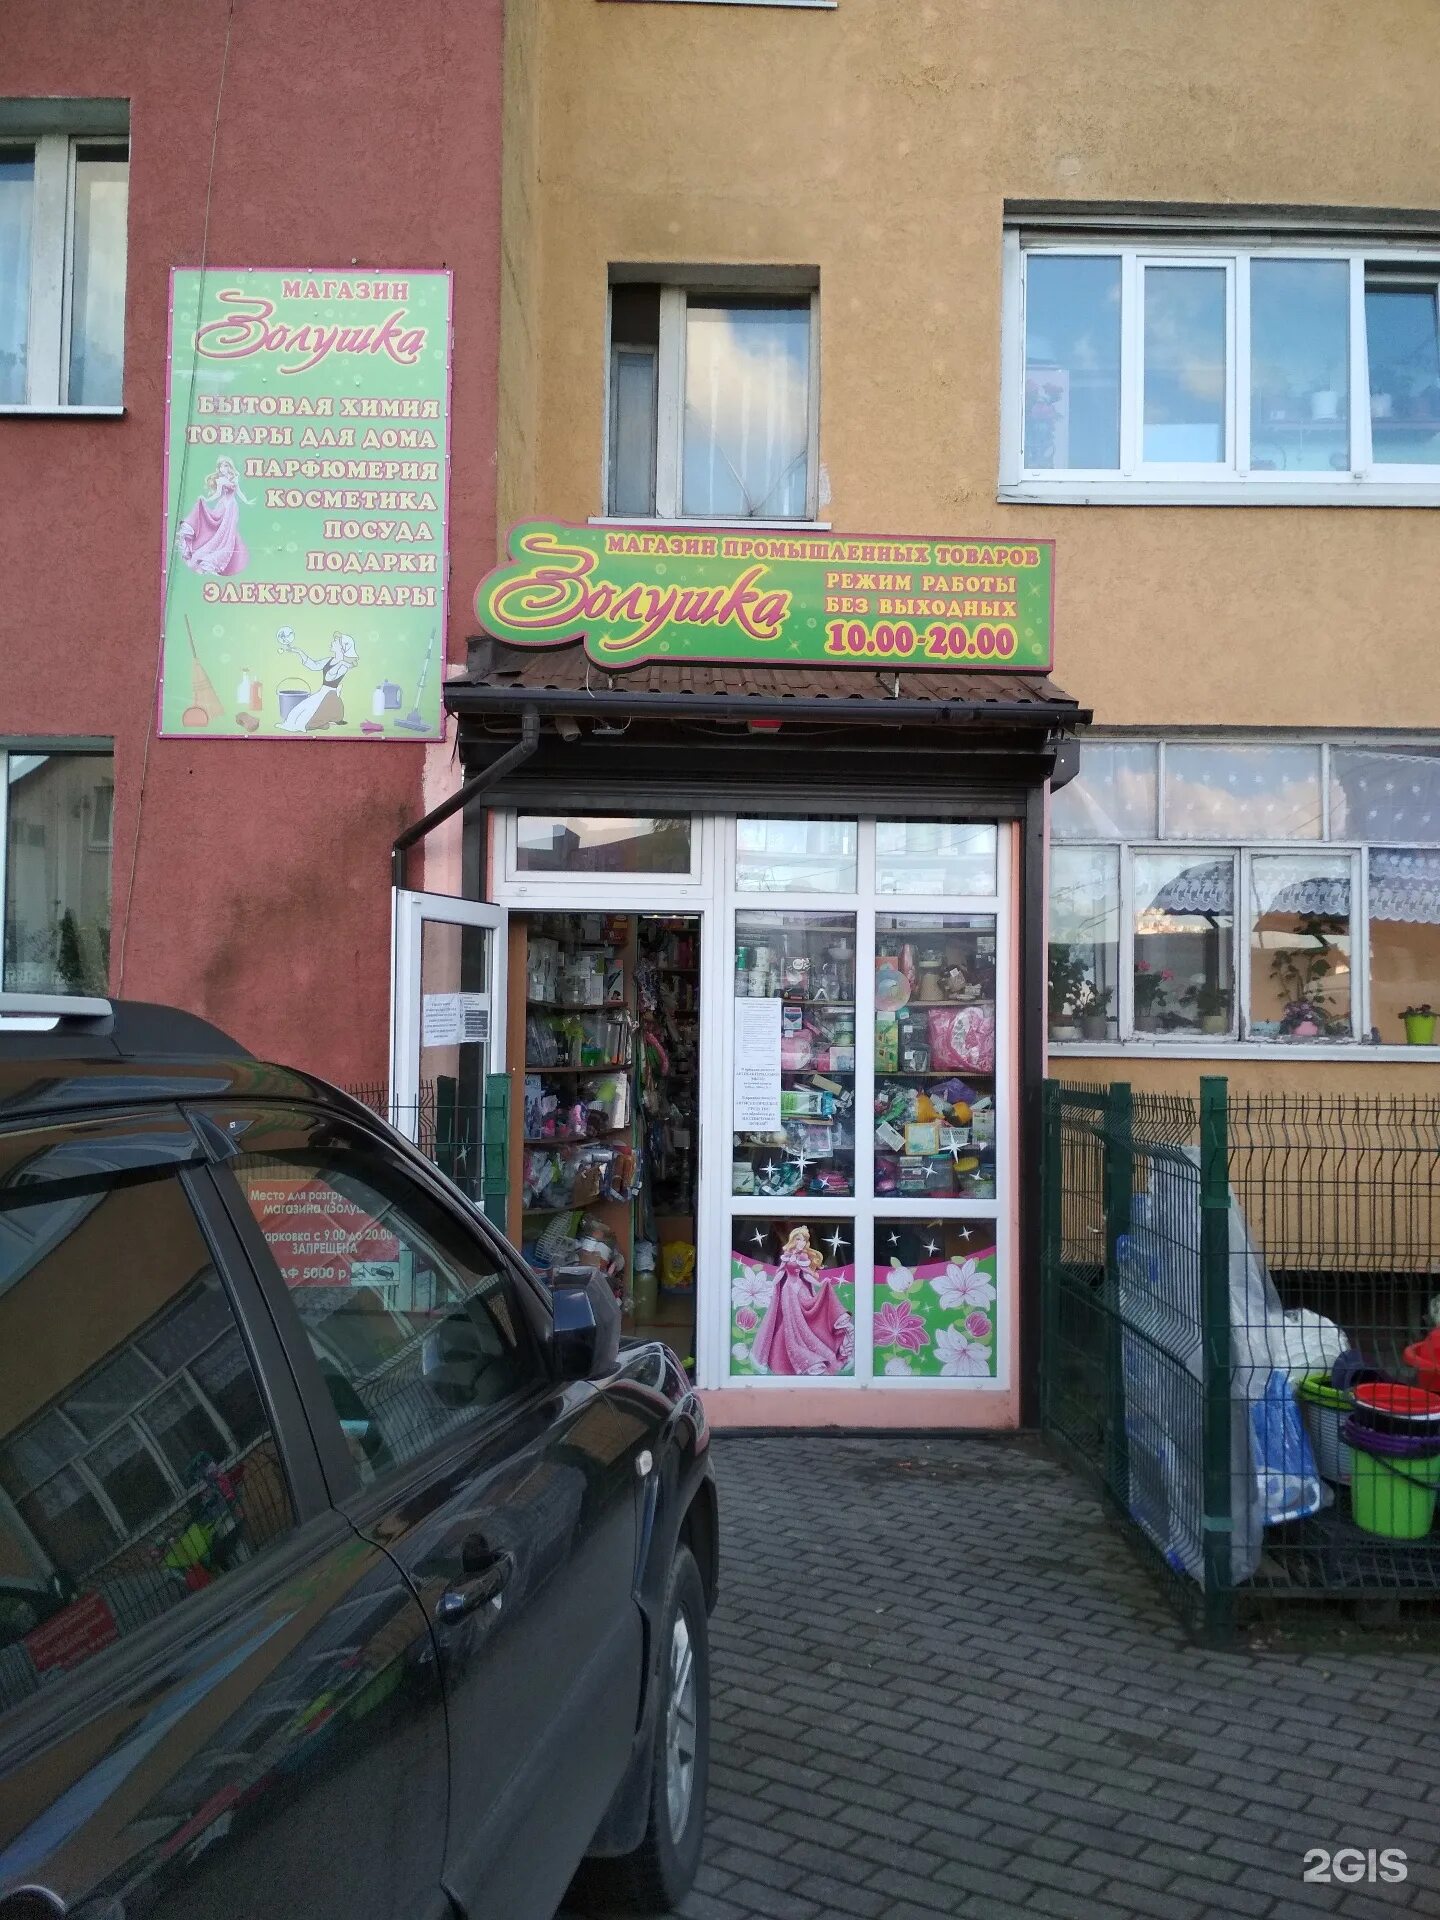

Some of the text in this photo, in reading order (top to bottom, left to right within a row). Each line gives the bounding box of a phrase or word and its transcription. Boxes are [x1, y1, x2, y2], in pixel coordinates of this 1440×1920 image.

[282, 280, 408, 301] МАГАЗИН
[195, 290, 427, 375] Золушка
[198, 396, 440, 419] БЫТОВАЯ ХИМИЯ
[186, 425, 438, 449] ТОВАРЫ ДЛЯ ДОМА
[245, 458, 438, 480] ПАРФЮМЕРИЯ
[265, 488, 438, 511] КОСМЕТИКА
[323, 519, 434, 541] ПОСУДА
[607, 534, 1040, 566] МАГАЗИН ПРОМЫШЛЕННЫХ ТОВАРОВ
[305, 551, 437, 573] ПОДАРКИ
[492, 535, 790, 651] Золушка
[826, 571, 1017, 594] РЕЖИМ РАБОТЫ
[203, 582, 437, 607] ЭЛЕКТРОТОВАРЫ
[826, 596, 1017, 618] БЕЗ ВЫХОДНЫХ
[827, 622, 1016, 657] 10.00-20.00
[251, 1190, 285, 1201] Место
[288, 1191, 306, 1202] для
[264, 1203, 320, 1214] магазина
[262, 1229, 392, 1243] арковка с 9.00 до 20.00
[293, 1243, 358, 1255] ЗАПРЕЩЕНА
[303, 1268, 334, 1279] 5000
